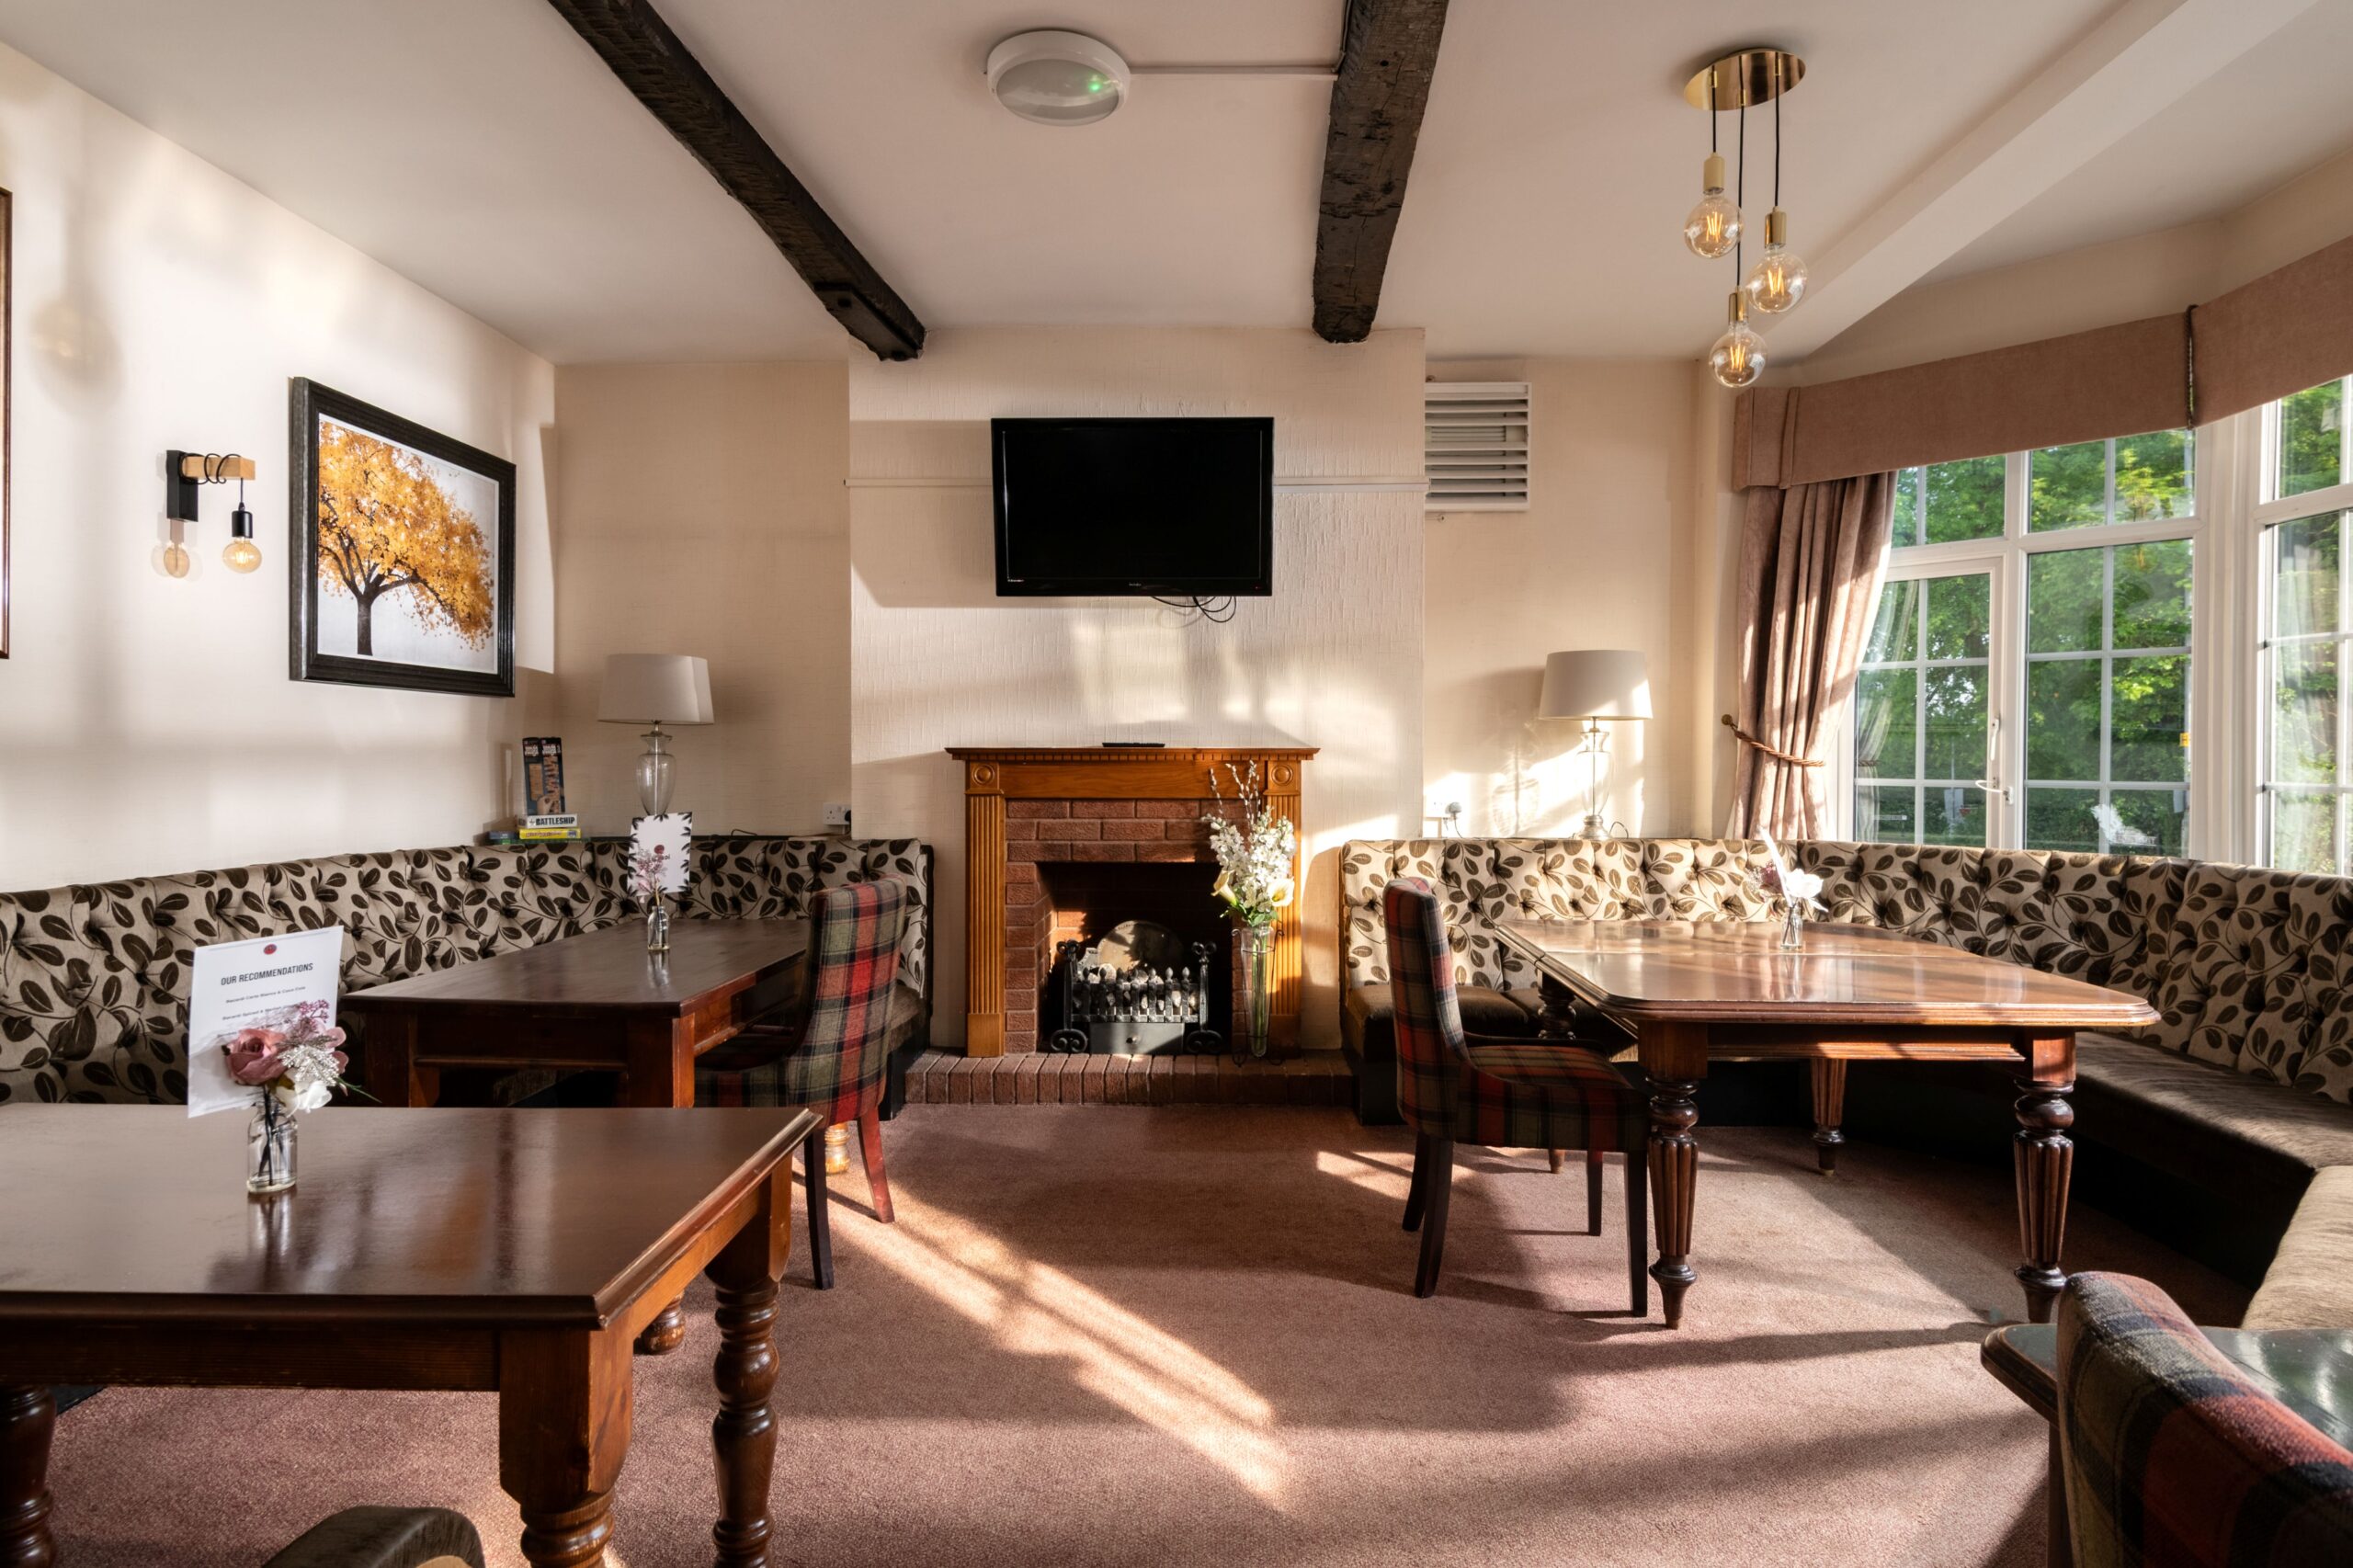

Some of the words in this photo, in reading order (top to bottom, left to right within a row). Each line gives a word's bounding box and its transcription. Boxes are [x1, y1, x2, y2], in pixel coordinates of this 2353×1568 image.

[536, 816, 575, 825] BATTLESHIP
[221, 975, 237, 986] OUR
[239, 962, 313, 983] RECOMMENDATIONS
